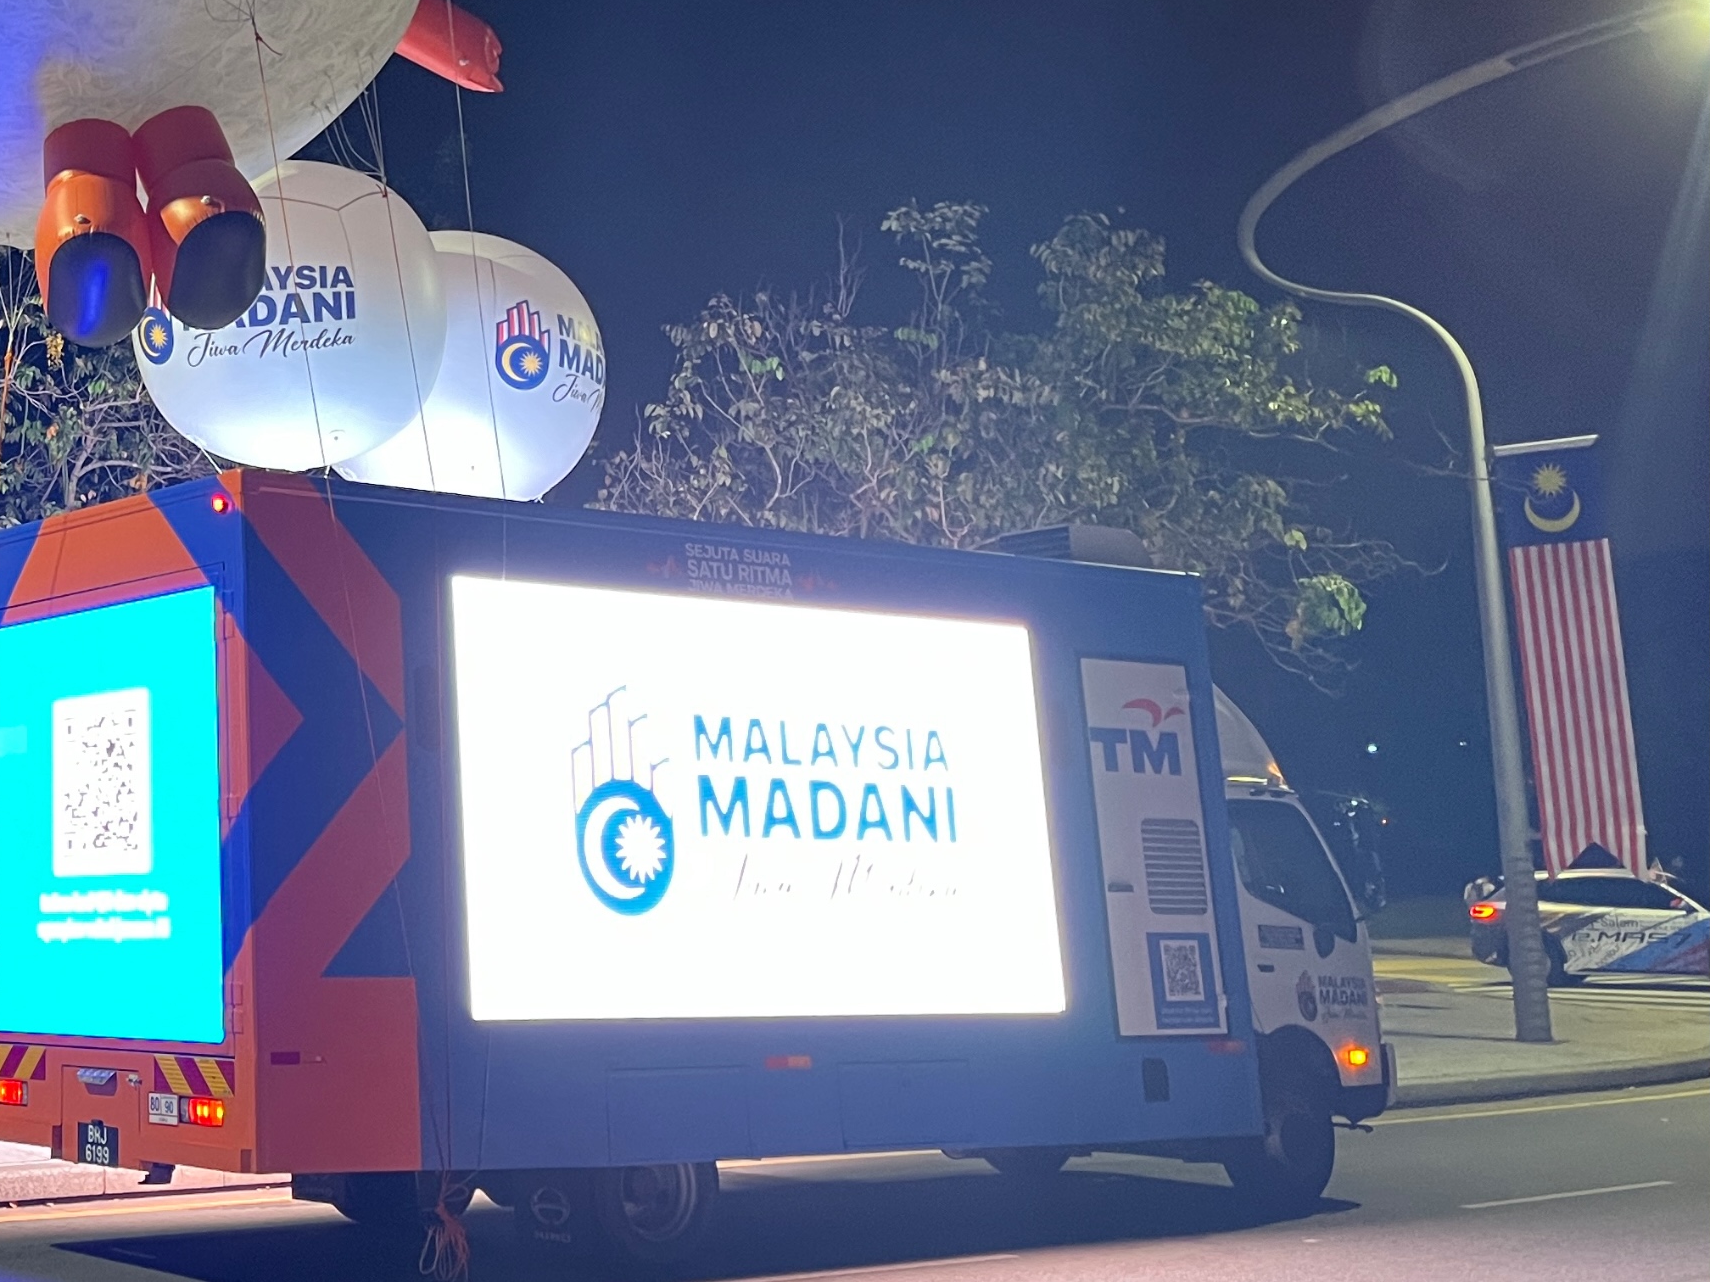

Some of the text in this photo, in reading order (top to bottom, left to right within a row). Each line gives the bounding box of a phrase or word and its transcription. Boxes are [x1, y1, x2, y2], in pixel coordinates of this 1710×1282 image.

[186, 327, 356, 368] Jiwa Merdeka
[685, 542, 792, 567] SEJUTA SUARA
[687, 559, 793, 586] SATU RITMA
[693, 713, 950, 772] MALAYSIA
[1089, 726, 1183, 776] TM
[696, 774, 958, 843] MADANI
[149, 1096, 175, 1114] 80 90
[85, 1144, 110, 1165] 6199
